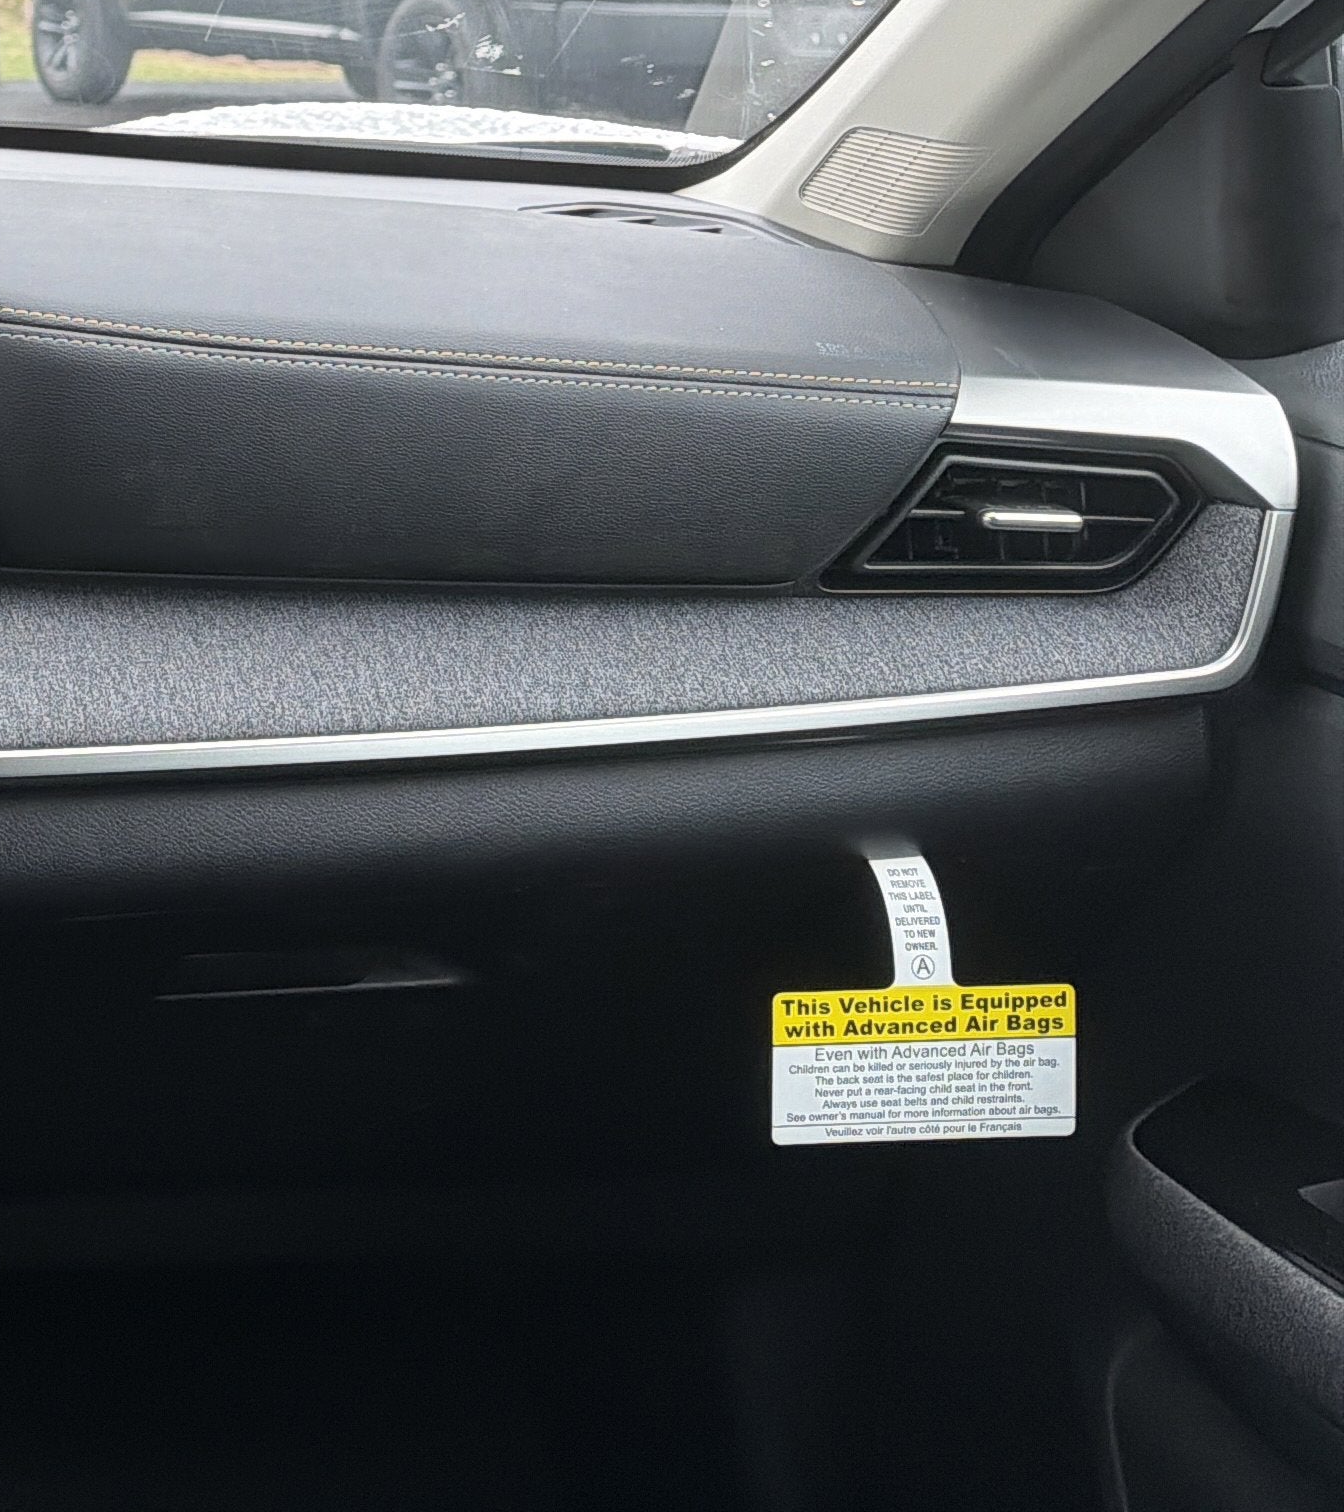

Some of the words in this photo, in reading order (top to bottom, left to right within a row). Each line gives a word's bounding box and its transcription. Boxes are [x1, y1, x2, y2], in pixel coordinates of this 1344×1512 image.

[886, 868, 900, 877] DO
[903, 868, 919, 877] NOT
[890, 879, 927, 888] REMOVE
[888, 891, 907, 901] THIS
[908, 891, 936, 900] LABEL
[903, 904, 928, 913] UNTIL
[895, 916, 941, 926] DELIVERED
[904, 930, 915, 938] TO
[918, 929, 936, 938] NEW
[781, 999, 831, 1017] This
[839, 994, 925, 1015] Vehicle
[933, 994, 953, 1012] is
[960, 991, 1067, 1012] Equipped
[785, 1020, 835, 1038] with
[843, 1016, 957, 1037] Advanced
[965, 1015, 999, 1033] Air
[1007, 1013, 1064, 1034] Bags
[815, 1047, 852, 1061] Even
[857, 1046, 888, 1060] with
[891, 1043, 966, 1060] Advanced
[970, 1042, 992, 1057] Air
[996, 1041, 1035, 1058] Bags
[788, 1064, 830, 1075] Children
[832, 1064, 850, 1073] can
[853, 1062, 865, 1072] be
[868, 1061, 893, 1071] killed
[896, 1062, 906, 1071] or
[908, 1060, 952, 1071] seriously
[991, 1058, 1002, 1070] by
[1005, 1057, 1020, 1067] the
[1023, 1057, 1036, 1067] air
[1038, 1057, 1060, 1068] bag.
[815, 1075, 834, 1086] The
[837, 1075, 860, 1085] back
[862, 1075, 883, 1084] seat
[886, 1074, 894, 1083] is
[897, 1073, 912, 1082] the
[915, 1072, 945, 1082] safest
[947, 1071, 973, 1083] place
[976, 1071, 990, 1080] for
[991, 1070, 1034, 1080] children.
[815, 1088, 844, 1097] Never
[847, 1087, 863, 1098] put
[874, 1085, 927, 1096] rear-facing
[929, 1084, 952, 1094] child
[954, 1083, 976, 1093] seat
[978, 1083, 987, 1092] in
[990, 1082, 1005, 1091] the
[1007, 1081, 1034, 1091] front.
[822, 1099, 857, 1109] Always
[860, 1099, 878, 1108] use
[880, 1098, 902, 1107] seat
[904, 1097, 927, 1106] belts
[930, 1096, 949, 1106] and
[952, 1095, 974, 1105] child
[977, 1094, 1025, 1104] restraints.
[786, 1112, 806, 1122] See
[808, 1111, 847, 1121] owner's
[850, 1110, 885, 1119] manual
[888, 1109, 901, 1118] for
[904, 1109, 929, 1118] more
[931, 1107, 985, 1117] information
[988, 1106, 1016, 1115] about
[1019, 1105, 1032, 1114] air
[1033, 1104, 1061, 1115] bags.
[825, 1126, 863, 1136] Veuillez
[866, 1126, 884, 1135] voir
[886, 1125, 916, 1135] l'autre
[919, 1123, 940, 1134] côté
[943, 1124, 966, 1134] pour
[967, 1123, 977, 1132] le
[979, 1122, 1022, 1133] Français
